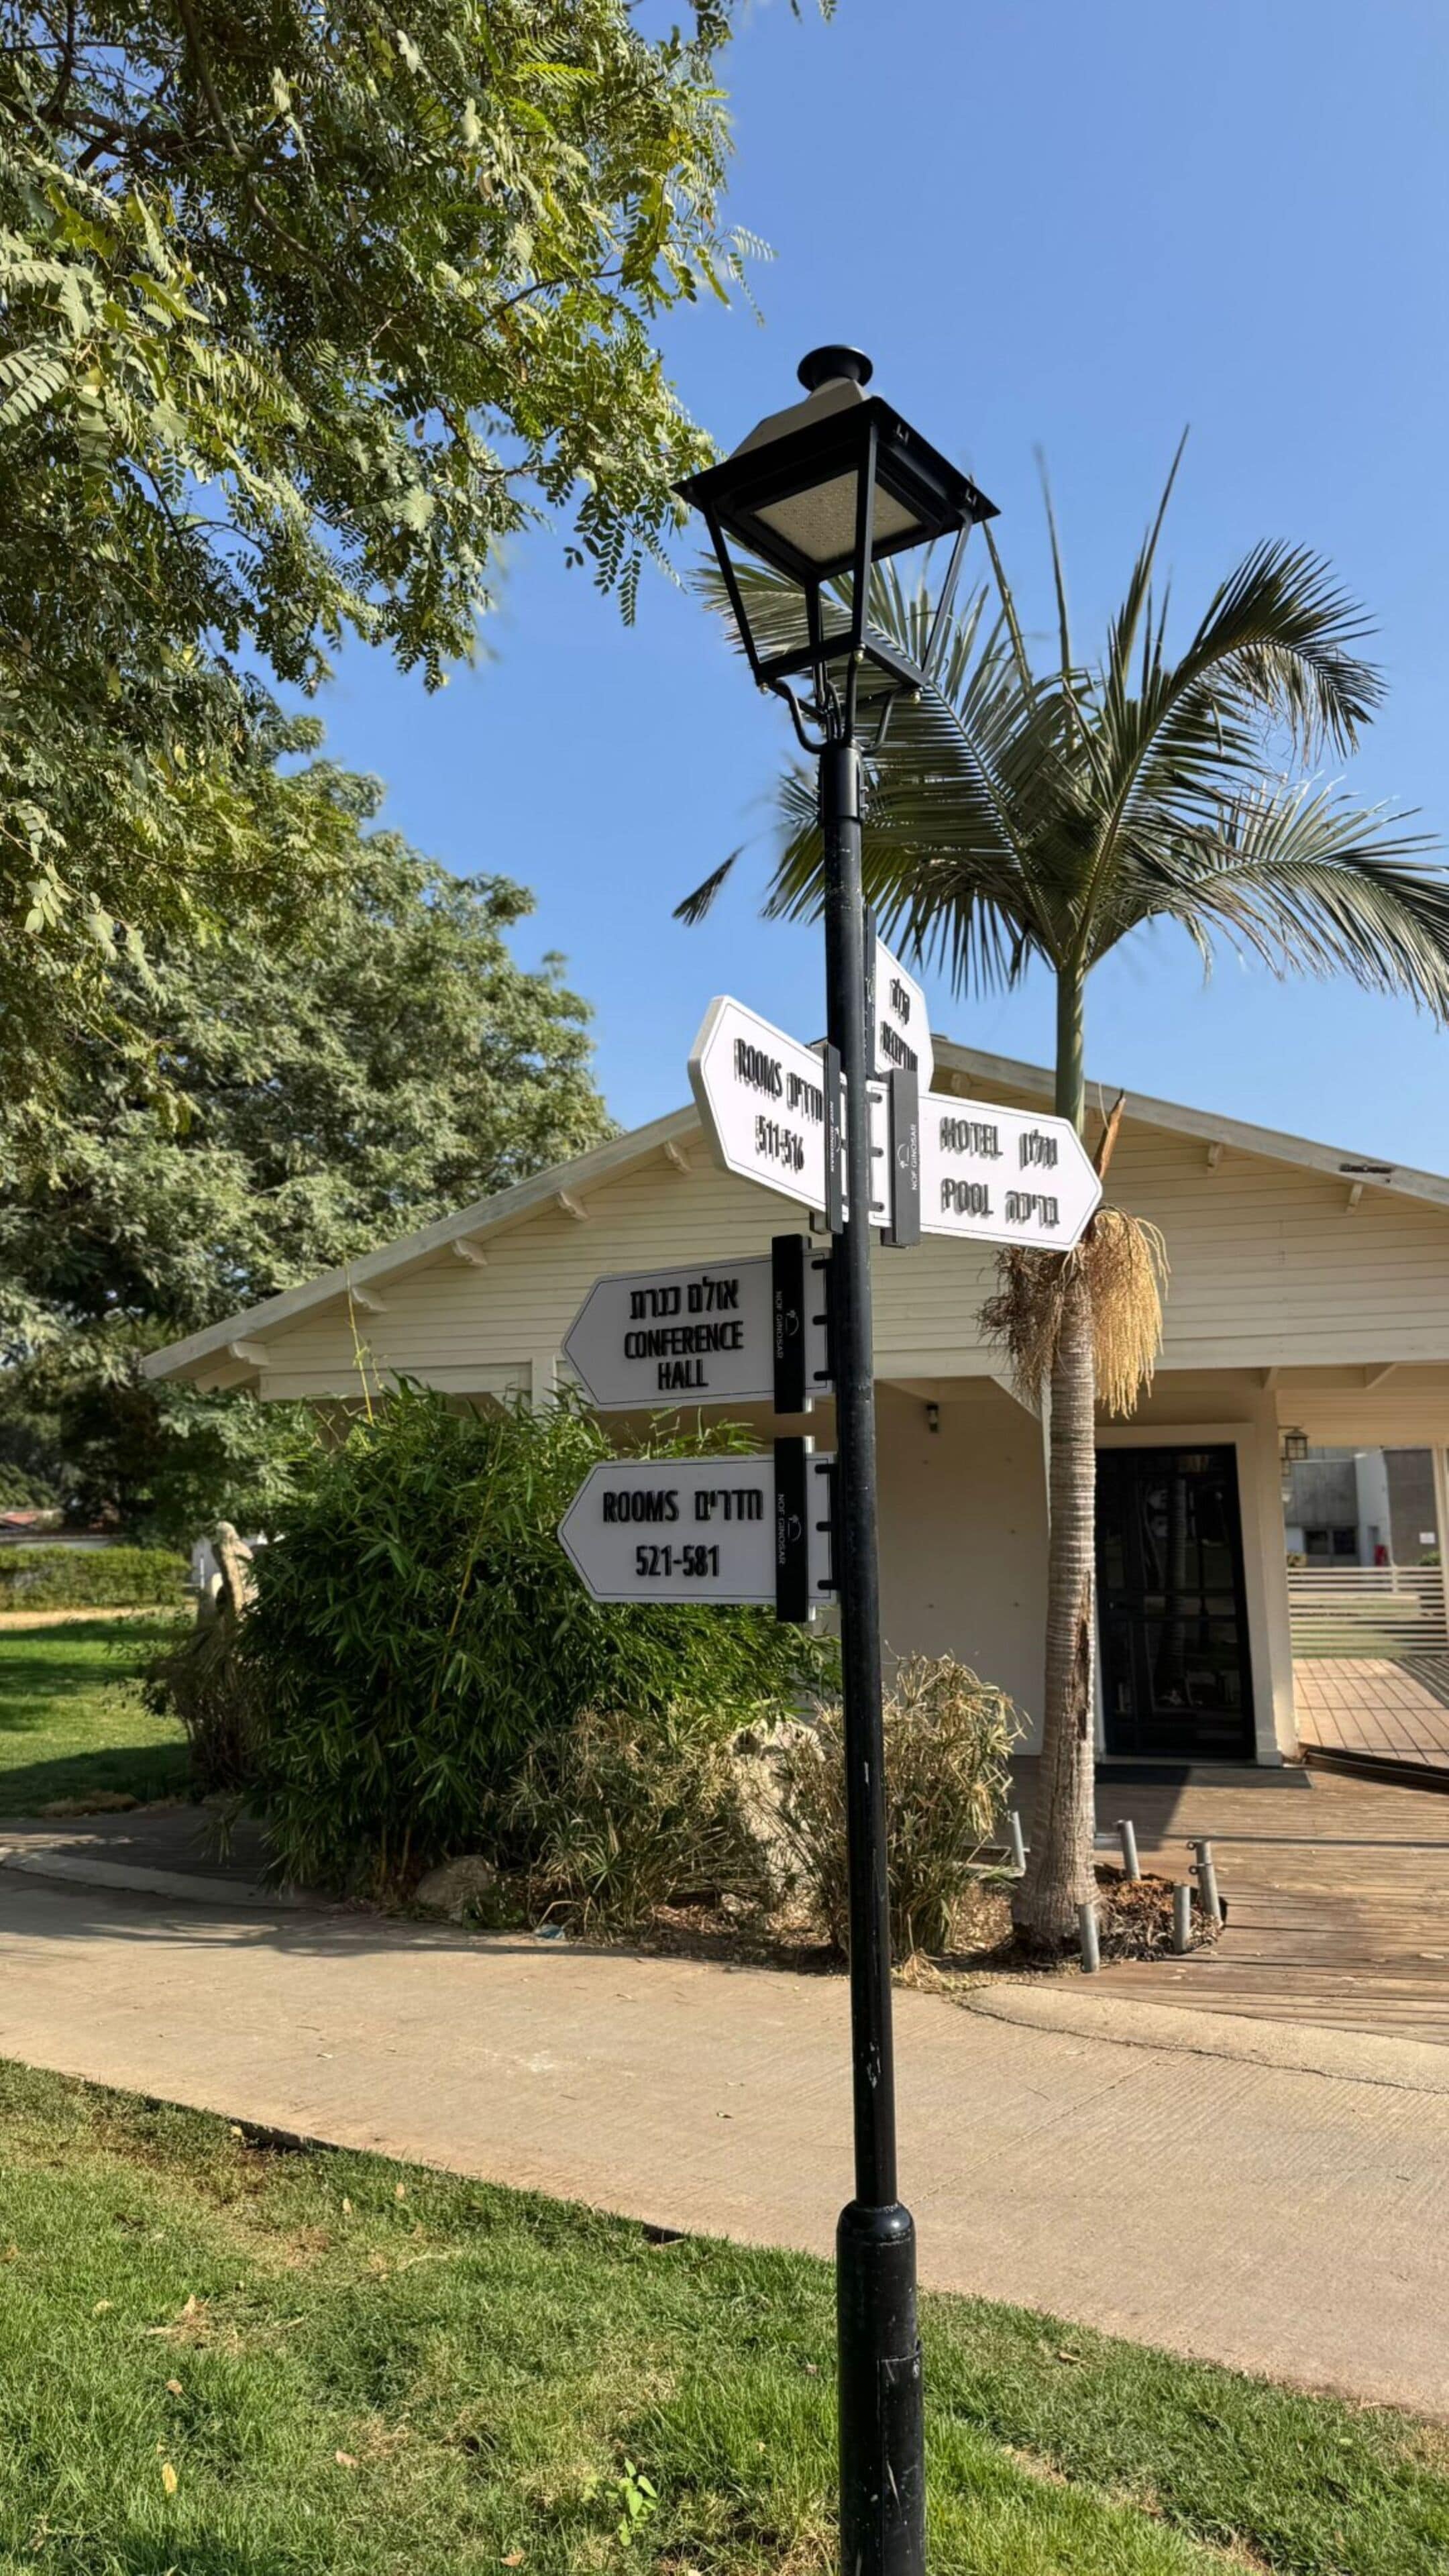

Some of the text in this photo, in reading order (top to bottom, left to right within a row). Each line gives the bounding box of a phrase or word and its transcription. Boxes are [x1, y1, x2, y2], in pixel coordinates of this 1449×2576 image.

[734, 1038, 823, 1126] ROOMS חדרים
[755, 1115, 804, 1174] 511-516
[940, 1116, 1058, 1170] HOTEL מלון
[941, 1177, 1060, 1229] POOL בריכה
[629, 1276, 739, 1320] אולם כנרת
[625, 1320, 744, 1359] CONFERENCE
[657, 1358, 709, 1390] HALL
[603, 1489, 763, 1523] ROOMS חדרים
[636, 1544, 719, 1577] 521-581
